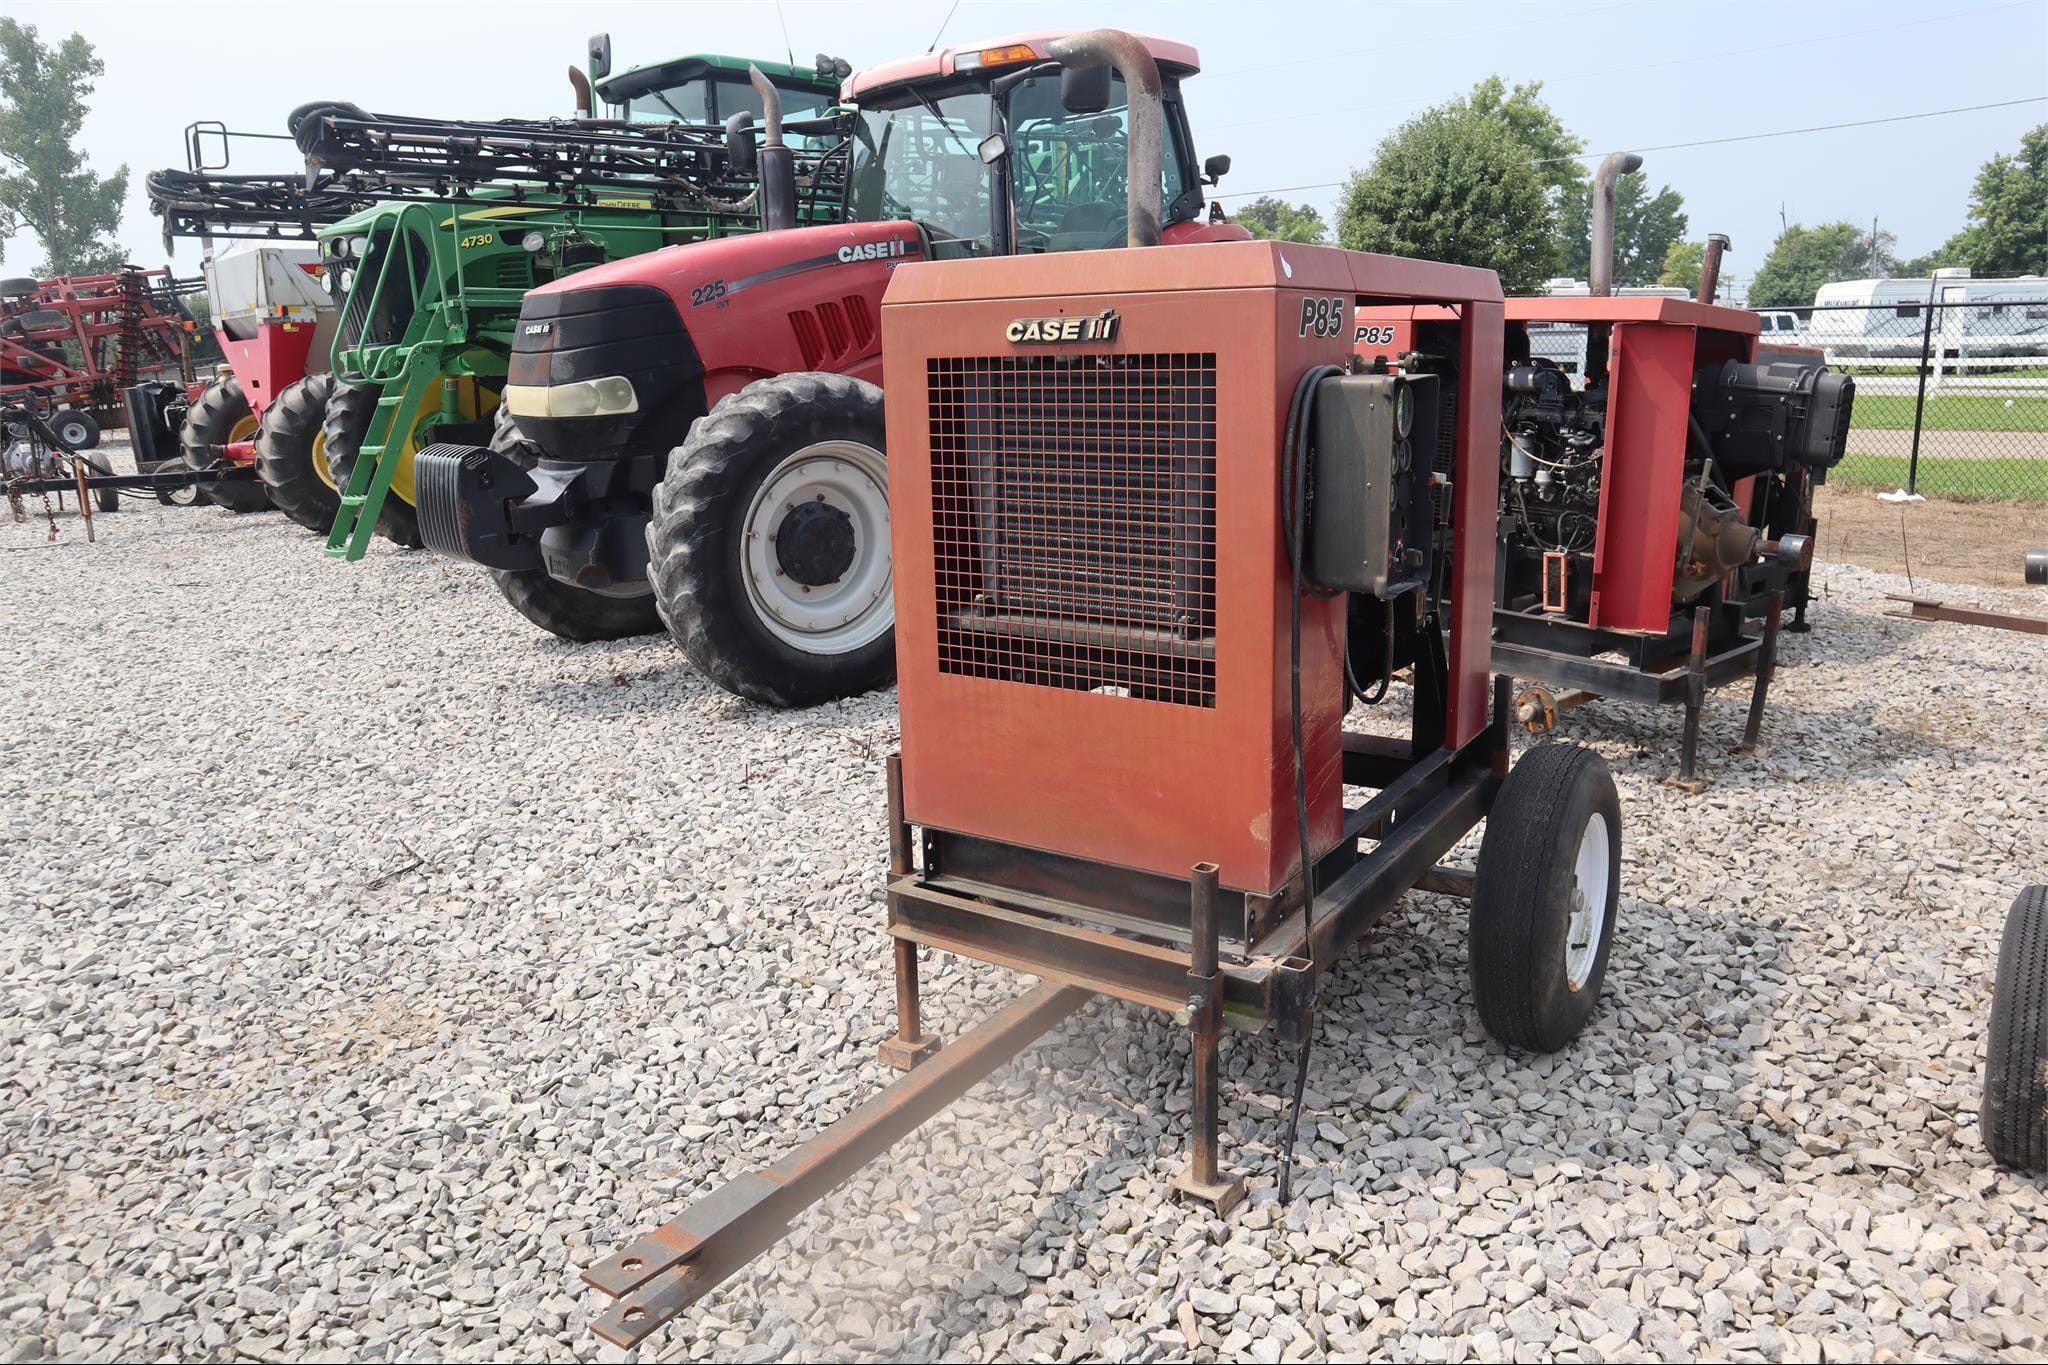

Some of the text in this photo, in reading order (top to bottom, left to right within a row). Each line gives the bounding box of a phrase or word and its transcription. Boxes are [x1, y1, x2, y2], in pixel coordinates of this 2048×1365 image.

[460, 233, 494, 249] 4730
[838, 242, 888, 263] CASE
[691, 278, 726, 308] 225
[1298, 297, 1344, 338] P85
[525, 325, 542, 335] CASE
[1005, 319, 1082, 343] CASE
[1354, 326, 1395, 345] P85
